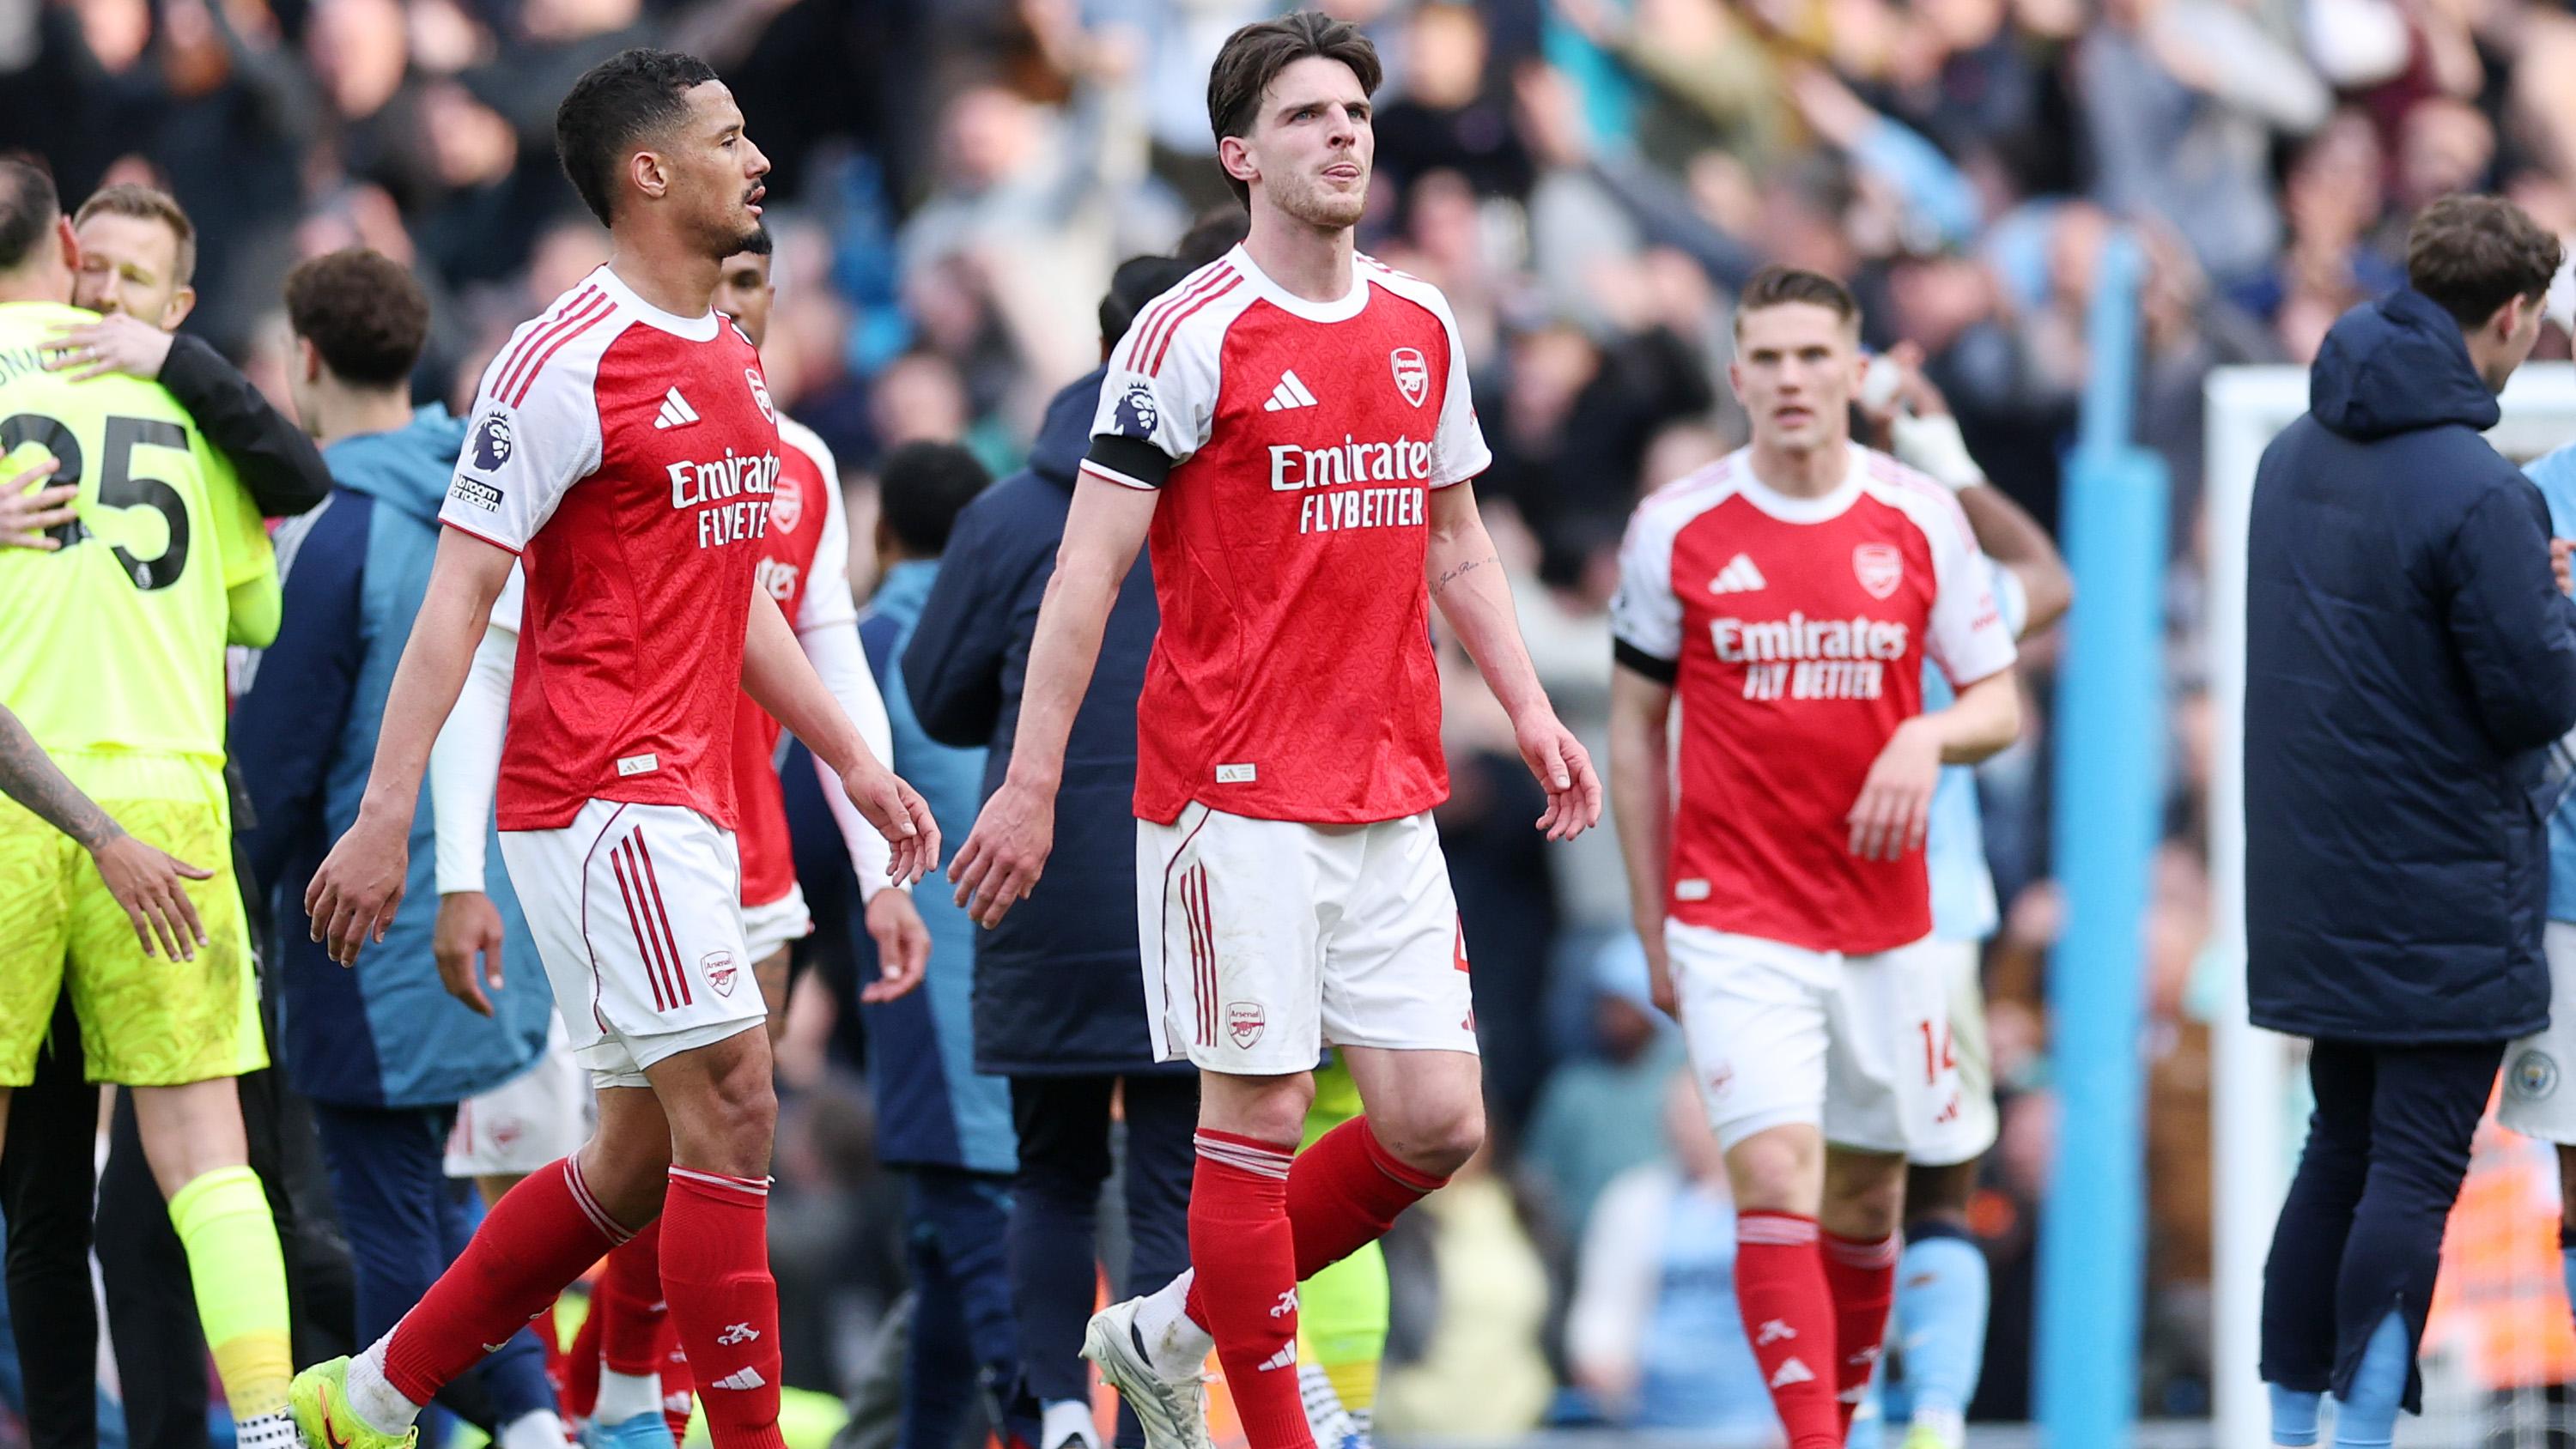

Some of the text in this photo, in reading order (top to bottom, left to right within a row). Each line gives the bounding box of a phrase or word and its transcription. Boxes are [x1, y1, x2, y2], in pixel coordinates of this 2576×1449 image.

[465, 480, 498, 501] room
[665, 447, 780, 509] Emirate
[1710, 609, 1910, 664] Emirates
[1742, 660, 1884, 701] FLY BETTER
[707, 956, 732, 968] Arsenal
[1230, 1009, 1259, 1018] Arsenal
